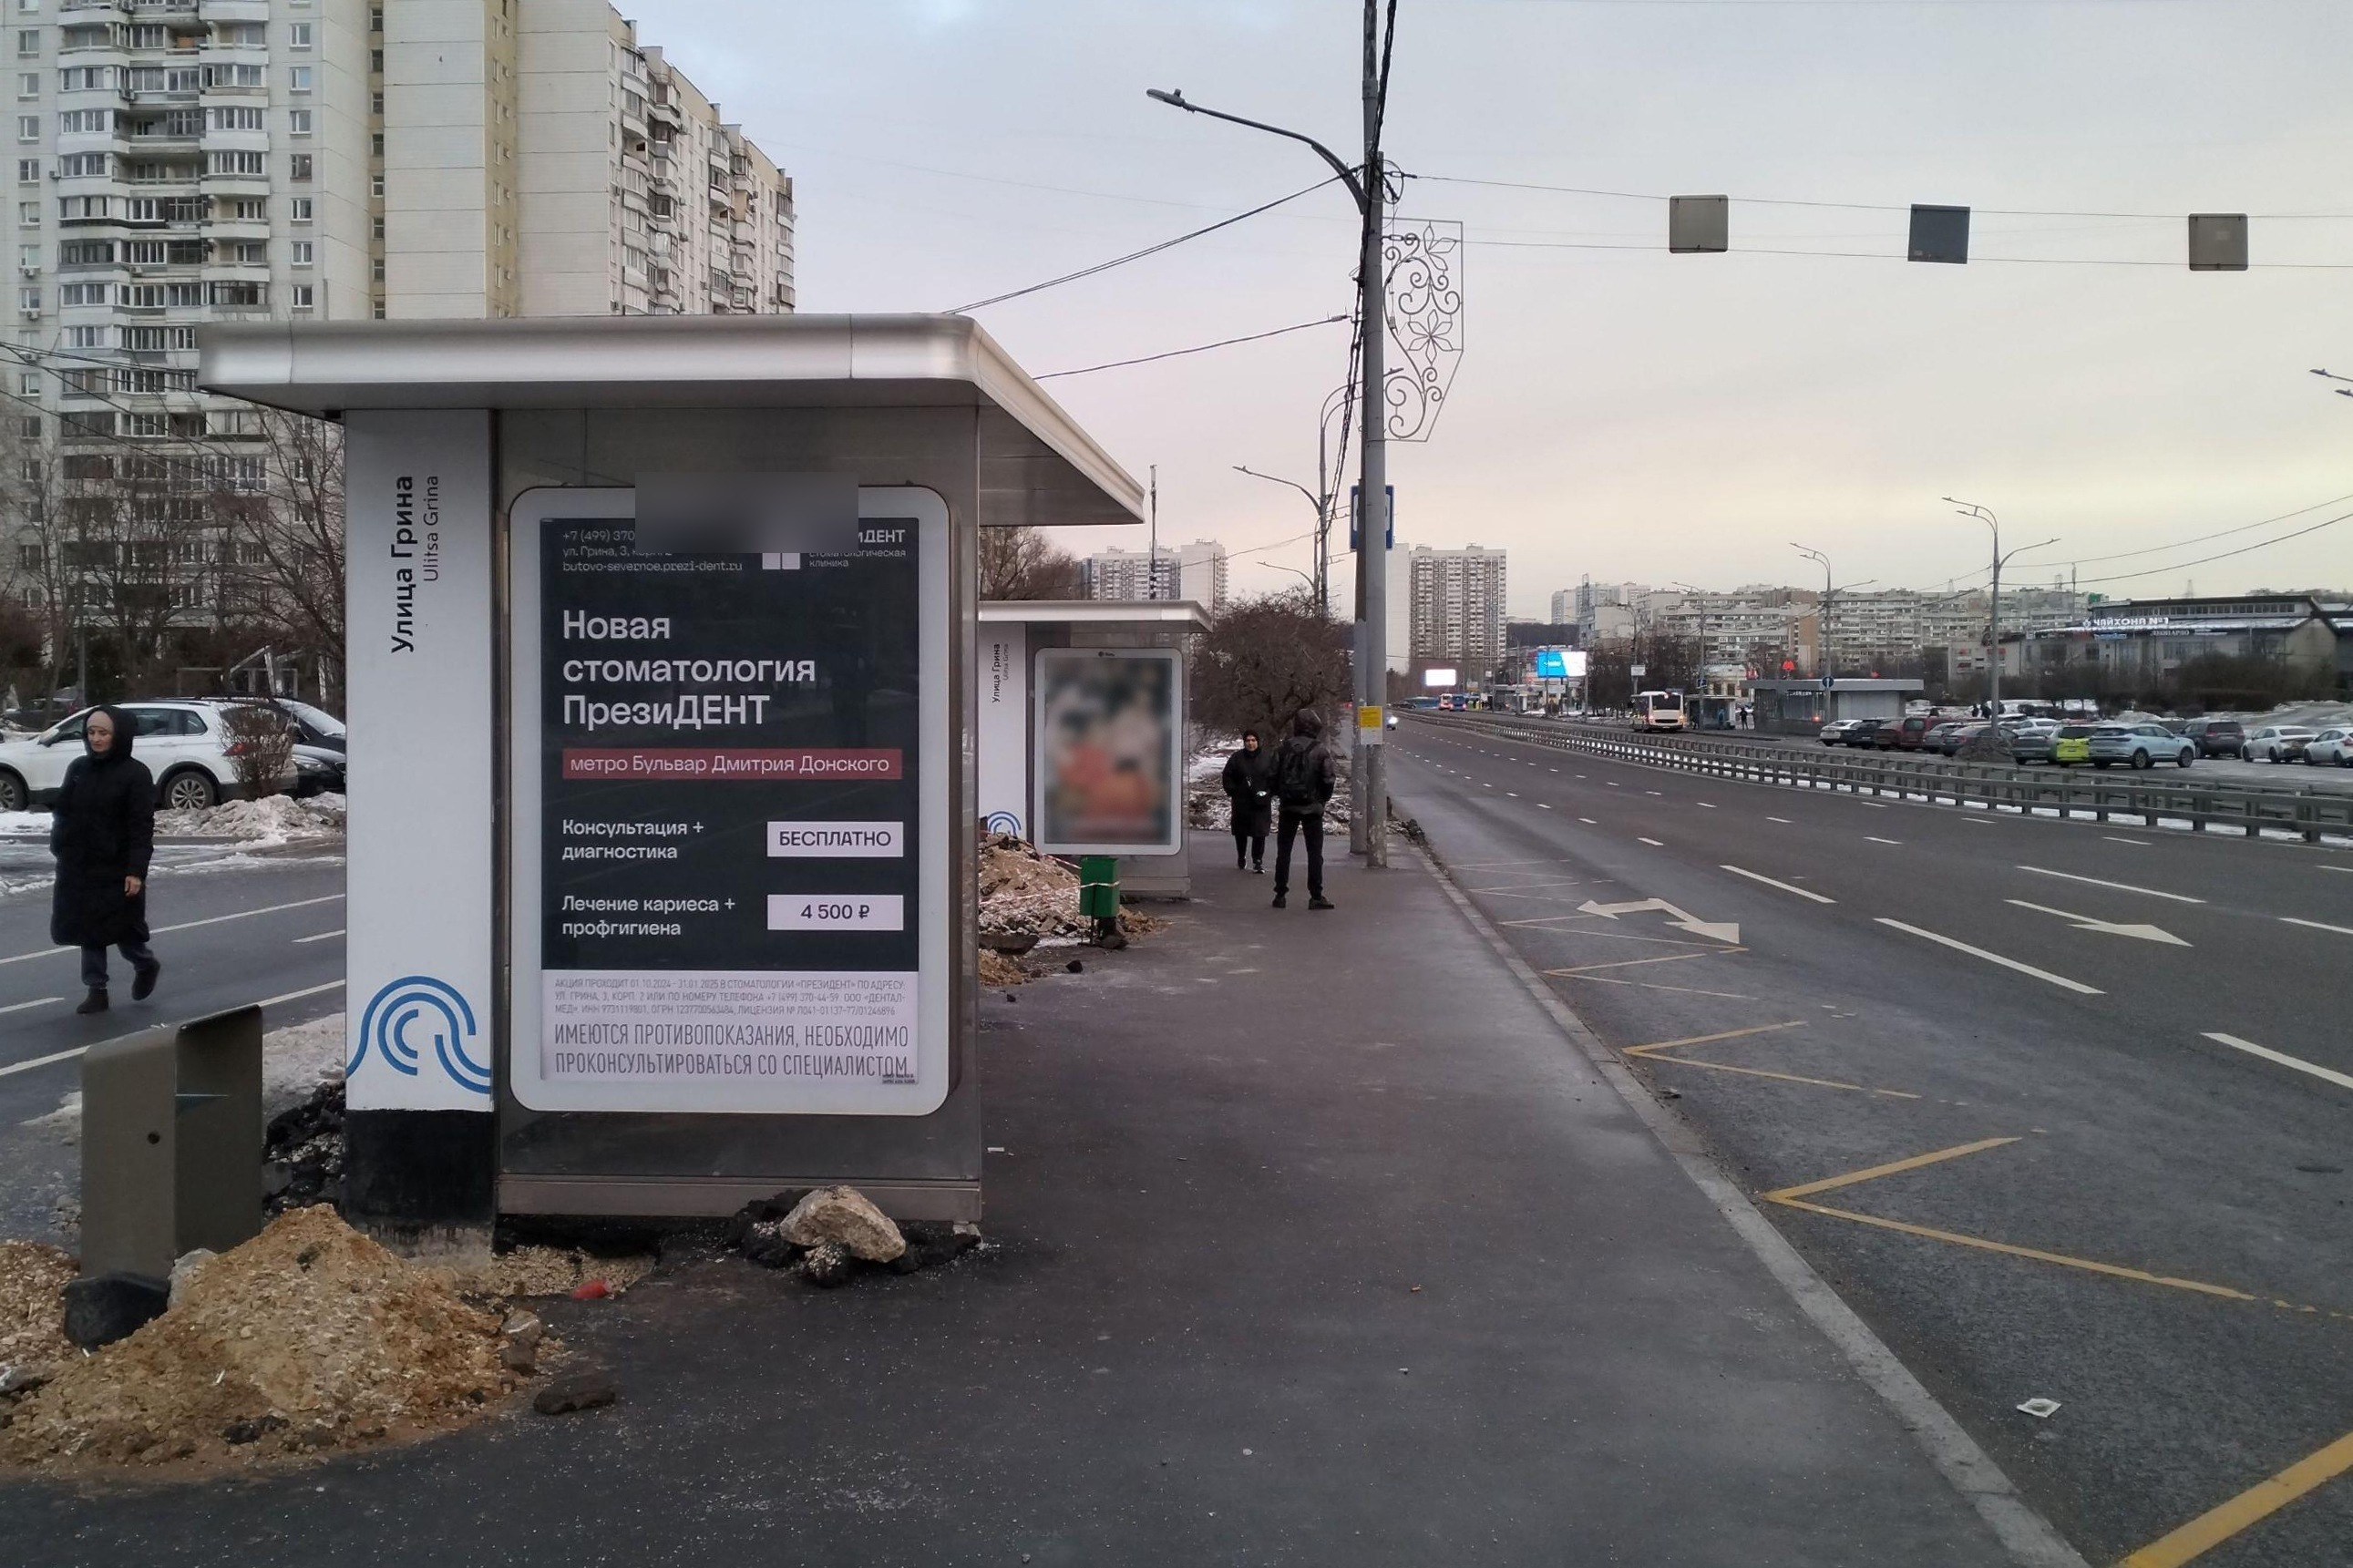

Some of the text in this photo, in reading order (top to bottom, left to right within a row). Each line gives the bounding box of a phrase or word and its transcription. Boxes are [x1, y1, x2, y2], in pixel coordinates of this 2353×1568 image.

[423, 476, 438, 581] Ulitsa Grina
[563, 530, 578, 541] +7
[581, 529, 610, 542] (499)
[562, 548, 578, 558] ул.
[581, 546, 618, 558] Грина,
[620, 546, 630, 557] 3,
[391, 476, 418, 653] Улица Грина
[562, 560, 743, 572] butovo-severnoe.prezi-dent.ru
[808, 559, 849, 568] клиника
[562, 610, 671, 640] Новая
[2093, 616, 2147, 627] ЧАЙХОНА
[562, 660, 817, 682] стоматология
[992, 643, 1002, 703] Улица Грина
[562, 695, 771, 731] ПрезиДЕНТ
[570, 755, 889, 774] метро Бульвар Дмитрия Донского
[562, 819, 704, 837] Консультация +
[779, 831, 892, 847] БЕСПЛАТНО
[562, 845, 678, 860] диагностика
[561, 895, 736, 913] Лечение кариеса +
[801, 905, 812, 919] 4
[817, 904, 853, 920] 500
[561, 920, 682, 937] профгигиена
[727, 979, 795, 989] СТОМАТОЛОГИИ
[858, 980, 869, 989] ПО
[683, 992, 716, 1001] НОМЕРУ
[737, 1006, 784, 1016] ЛИЦЕНЗИЯ
[554, 1023, 909, 1050] ИМЕЮТСЯ ПРОТИВОПОКАЗАНИЯ, НЕОБХОДИМО
[556, 1052, 752, 1075] ПРОКОНСУЛЬТИРОВАТЬСЯ
[757, 1054, 776, 1075] СО
